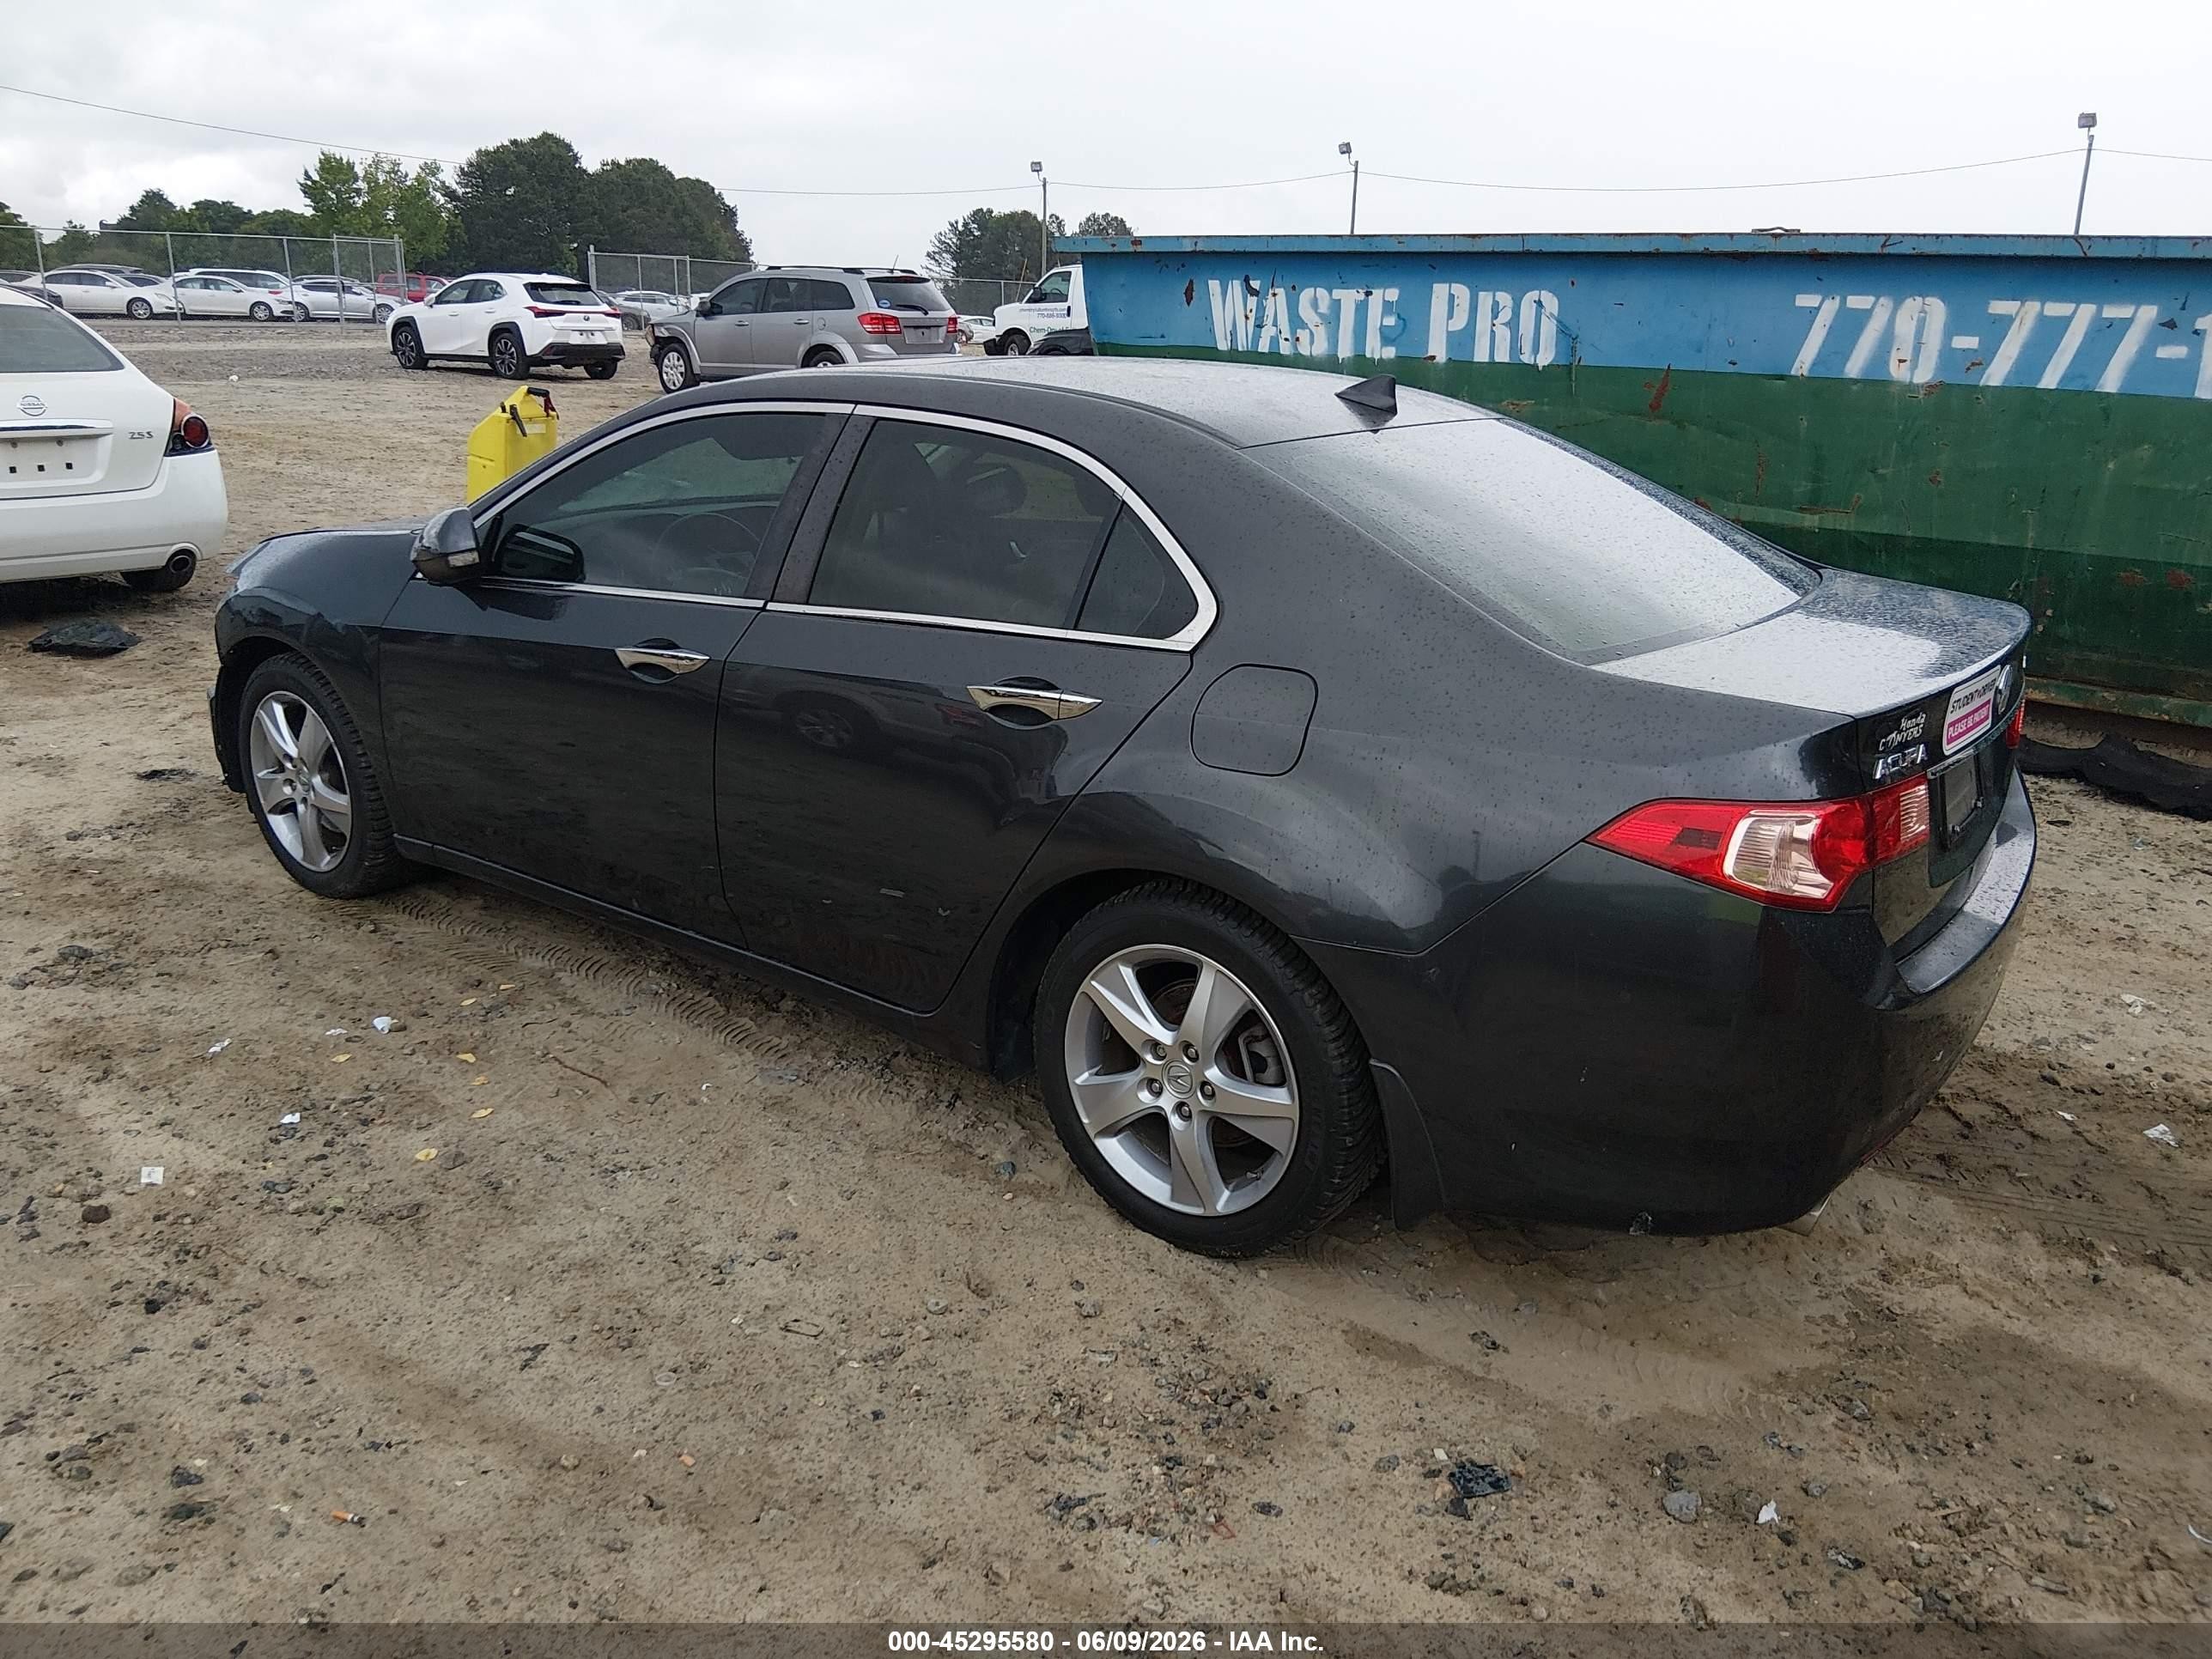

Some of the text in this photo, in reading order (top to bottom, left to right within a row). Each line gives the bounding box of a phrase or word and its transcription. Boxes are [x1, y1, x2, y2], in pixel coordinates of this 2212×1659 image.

[1207, 279, 1559, 366] WASTE PRO
[1949, 689, 1978, 714] STUDENT
[1899, 712, 1926, 731] Honda
[1948, 717, 1968, 739] PLEASE
